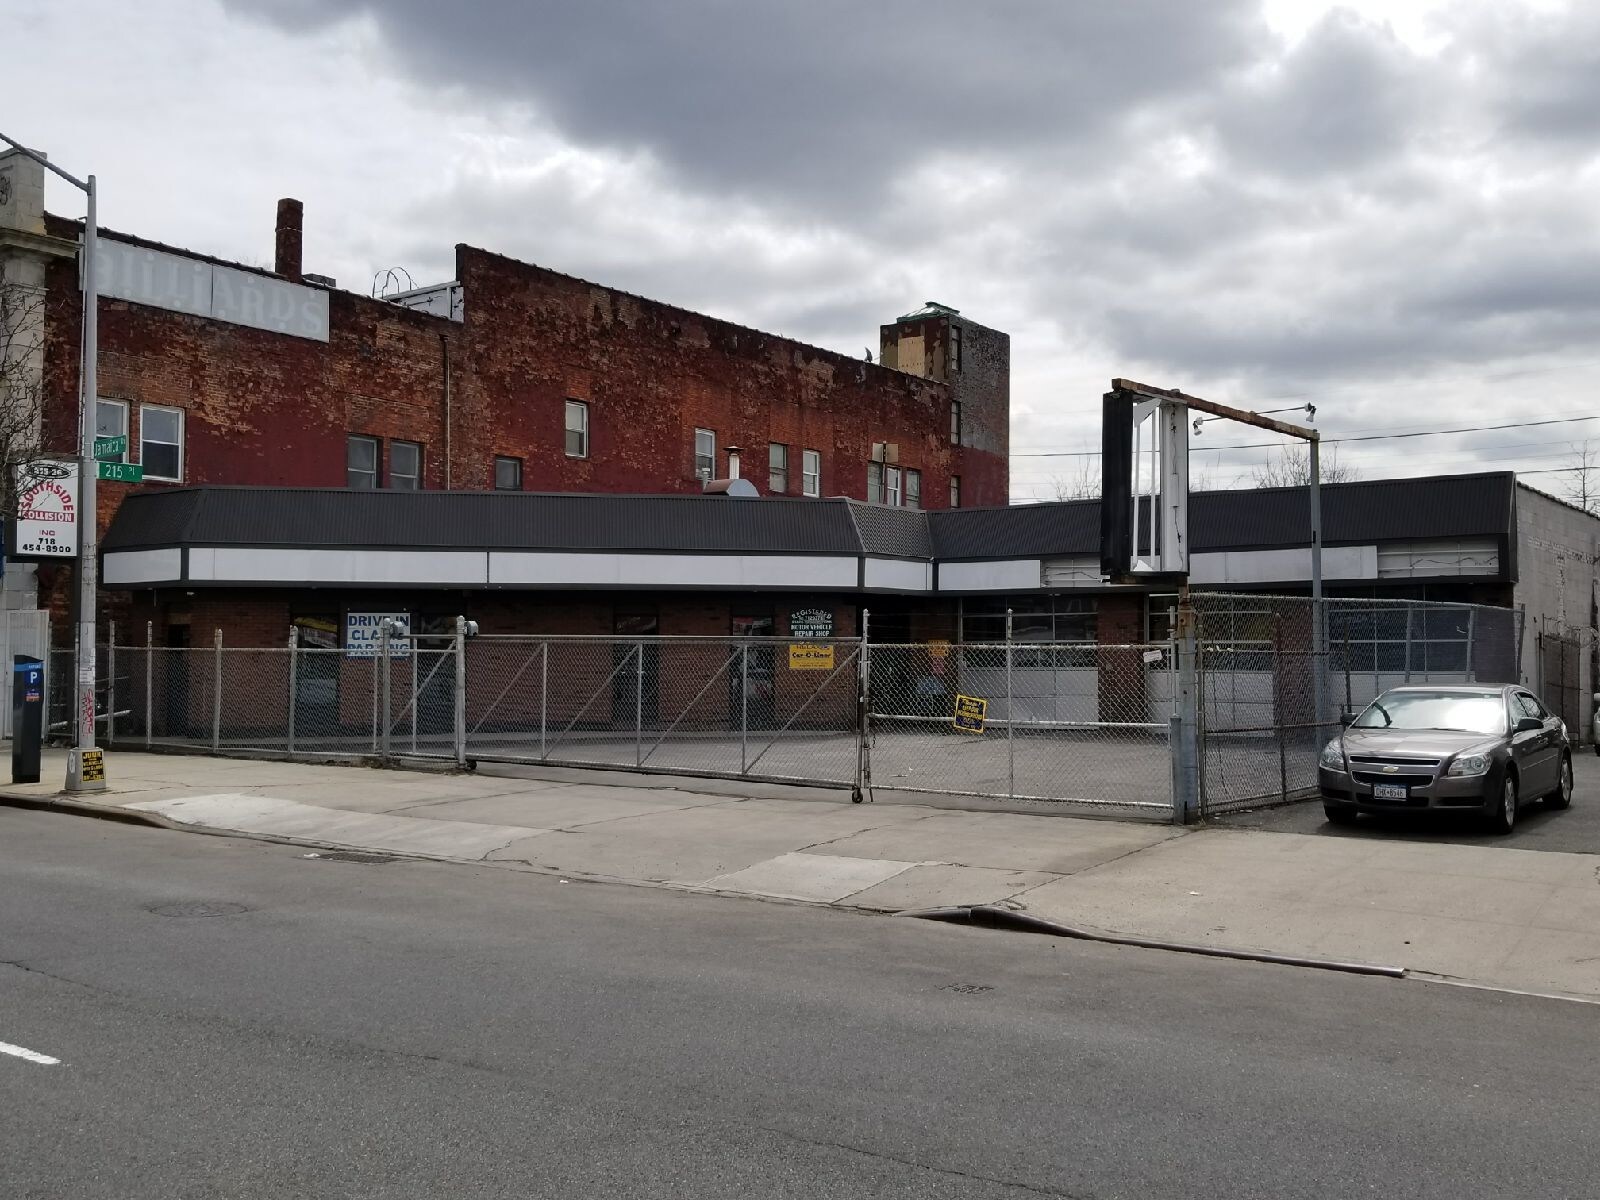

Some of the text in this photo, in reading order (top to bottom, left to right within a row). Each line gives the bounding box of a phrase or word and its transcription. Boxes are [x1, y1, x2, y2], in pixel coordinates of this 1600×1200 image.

[94, 439, 119, 457] Jamaica
[105, 464, 123, 479] 215
[21, 480, 74, 511] SOUTHSIDE
[23, 511, 72, 522] COLLISION
[22, 544, 71, 553] 454-8900
[30, 671, 38, 684] P
